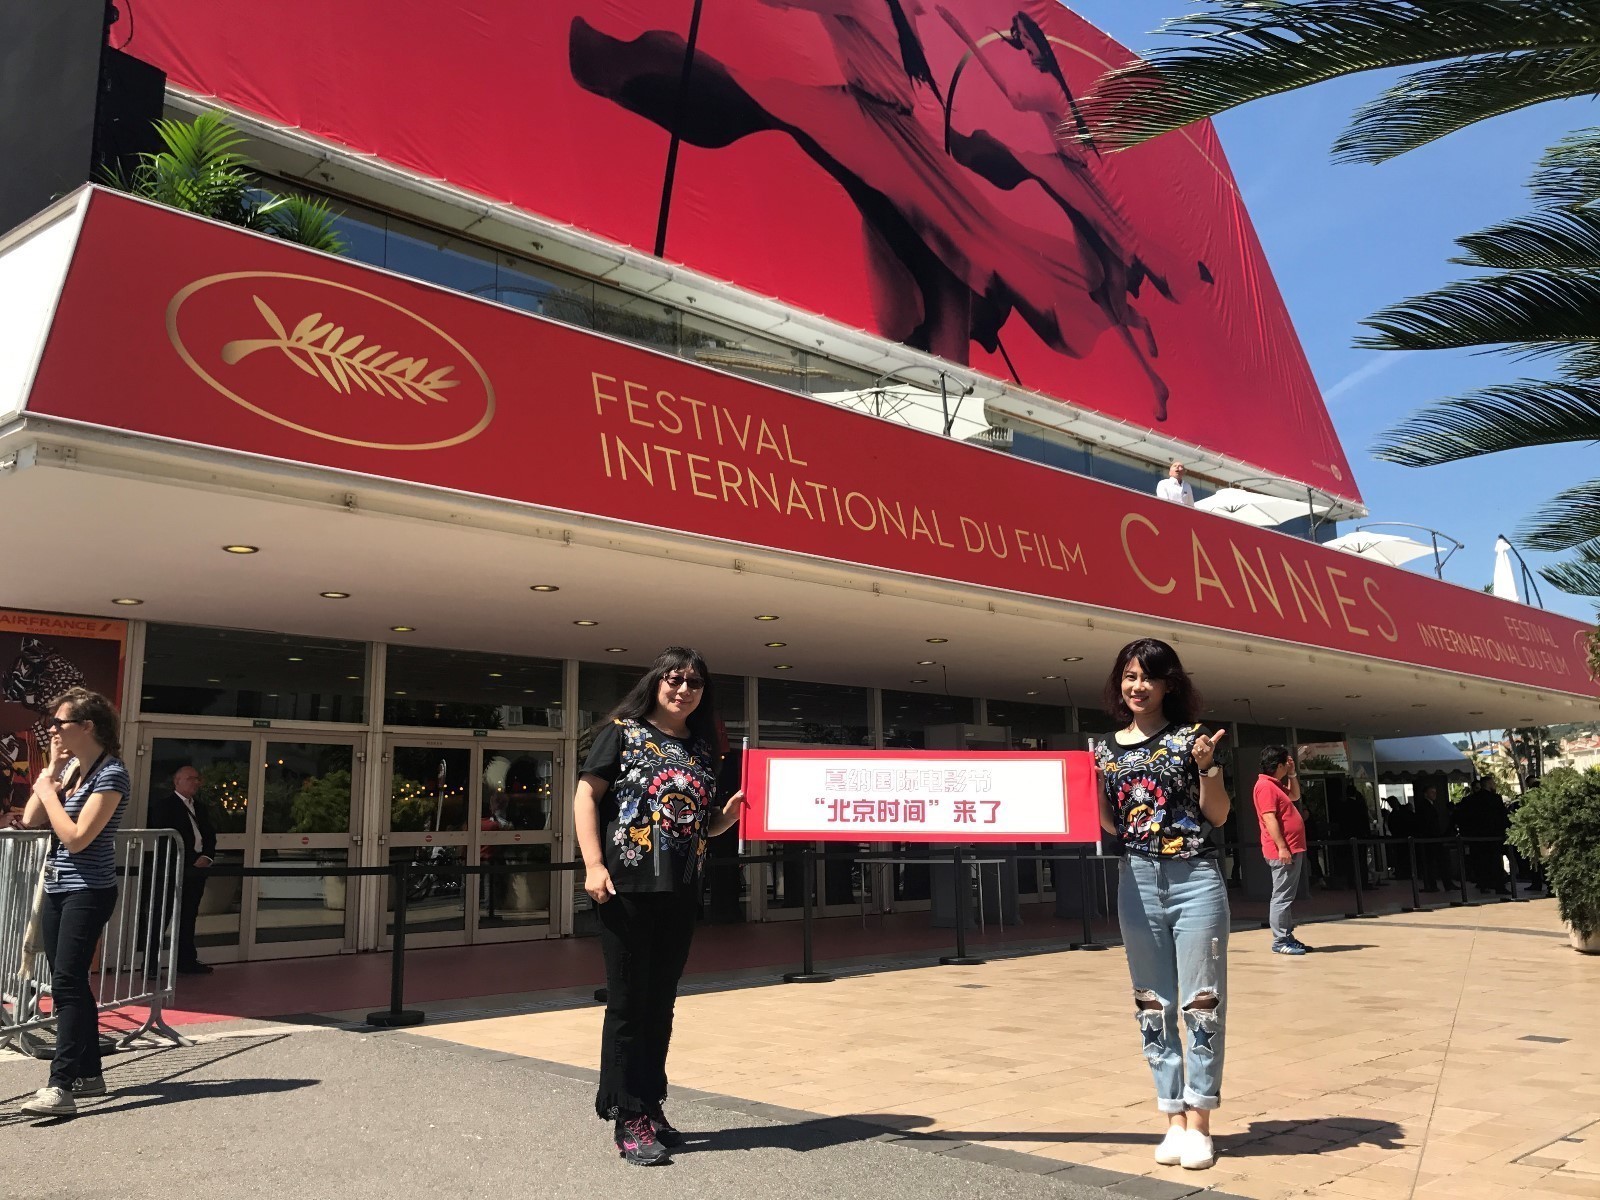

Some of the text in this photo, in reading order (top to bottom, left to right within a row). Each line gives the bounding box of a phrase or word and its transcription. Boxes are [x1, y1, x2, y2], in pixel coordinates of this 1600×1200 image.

[591, 371, 808, 467] FESTIVAL
[600, 432, 1088, 576] INTERNATIONAL DU FILM
[1120, 512, 1398, 643] CANNES
[1416, 621, 1571, 676] INTERNATIONAL DU FILM
[1503, 616, 1559, 649] FESTIVAL
[953, 799, 1002, 824] 来了
